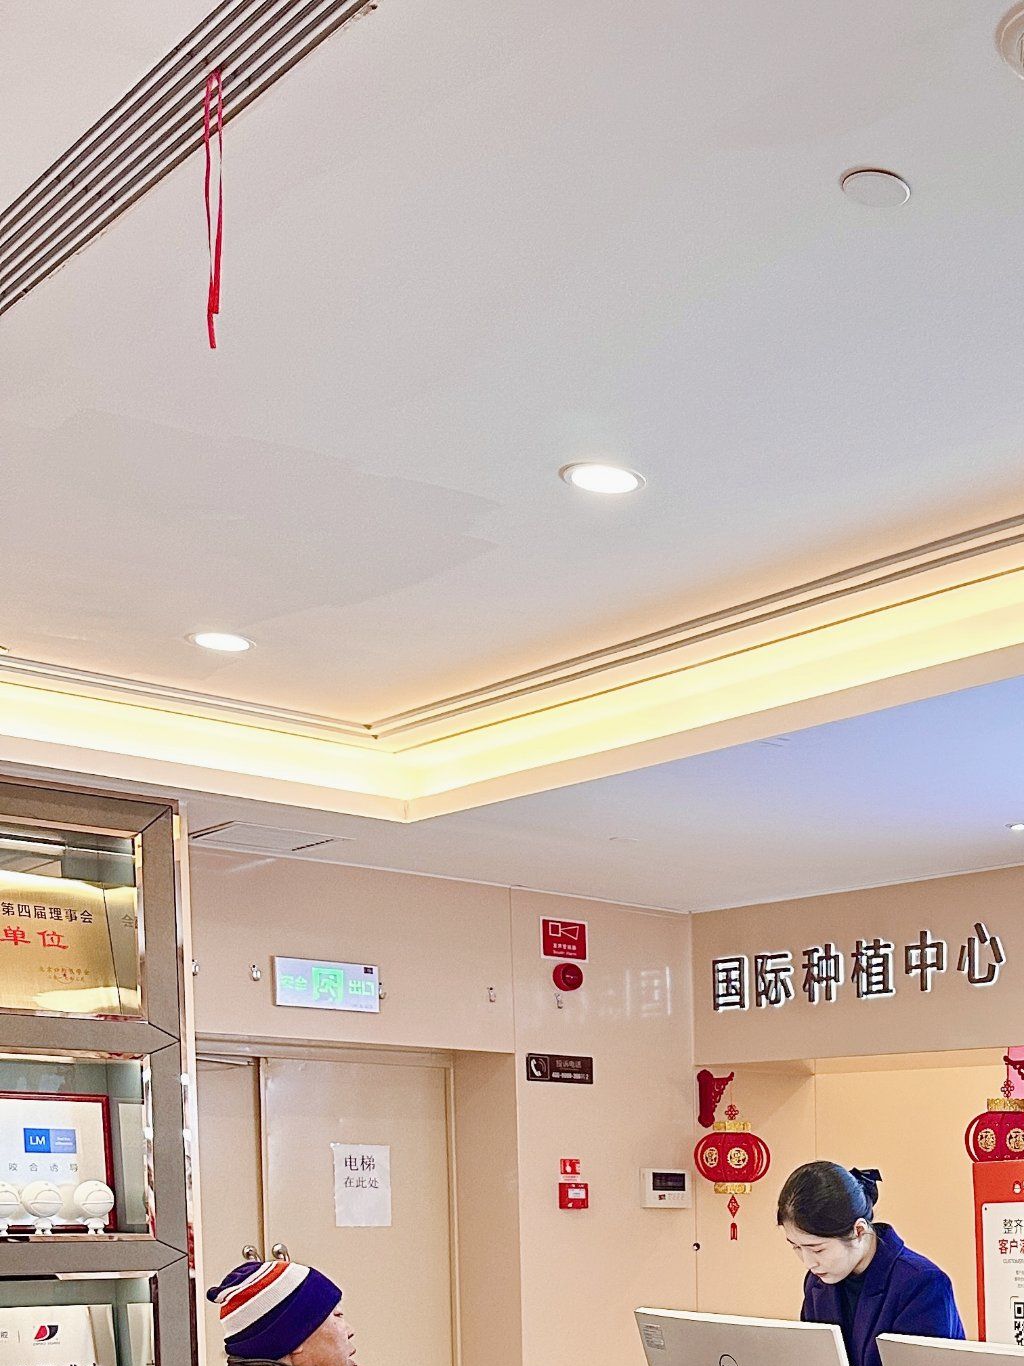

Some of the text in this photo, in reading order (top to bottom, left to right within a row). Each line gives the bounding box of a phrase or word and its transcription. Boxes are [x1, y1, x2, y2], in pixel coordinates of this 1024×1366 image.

[0, 901, 93, 924] 第四届理事会
[0, 926, 69, 950] 单位
[712, 922, 1006, 1014] 国际种植中心
[344, 1154, 376, 1171] 电梯
[344, 1176, 380, 1189] 在此处
